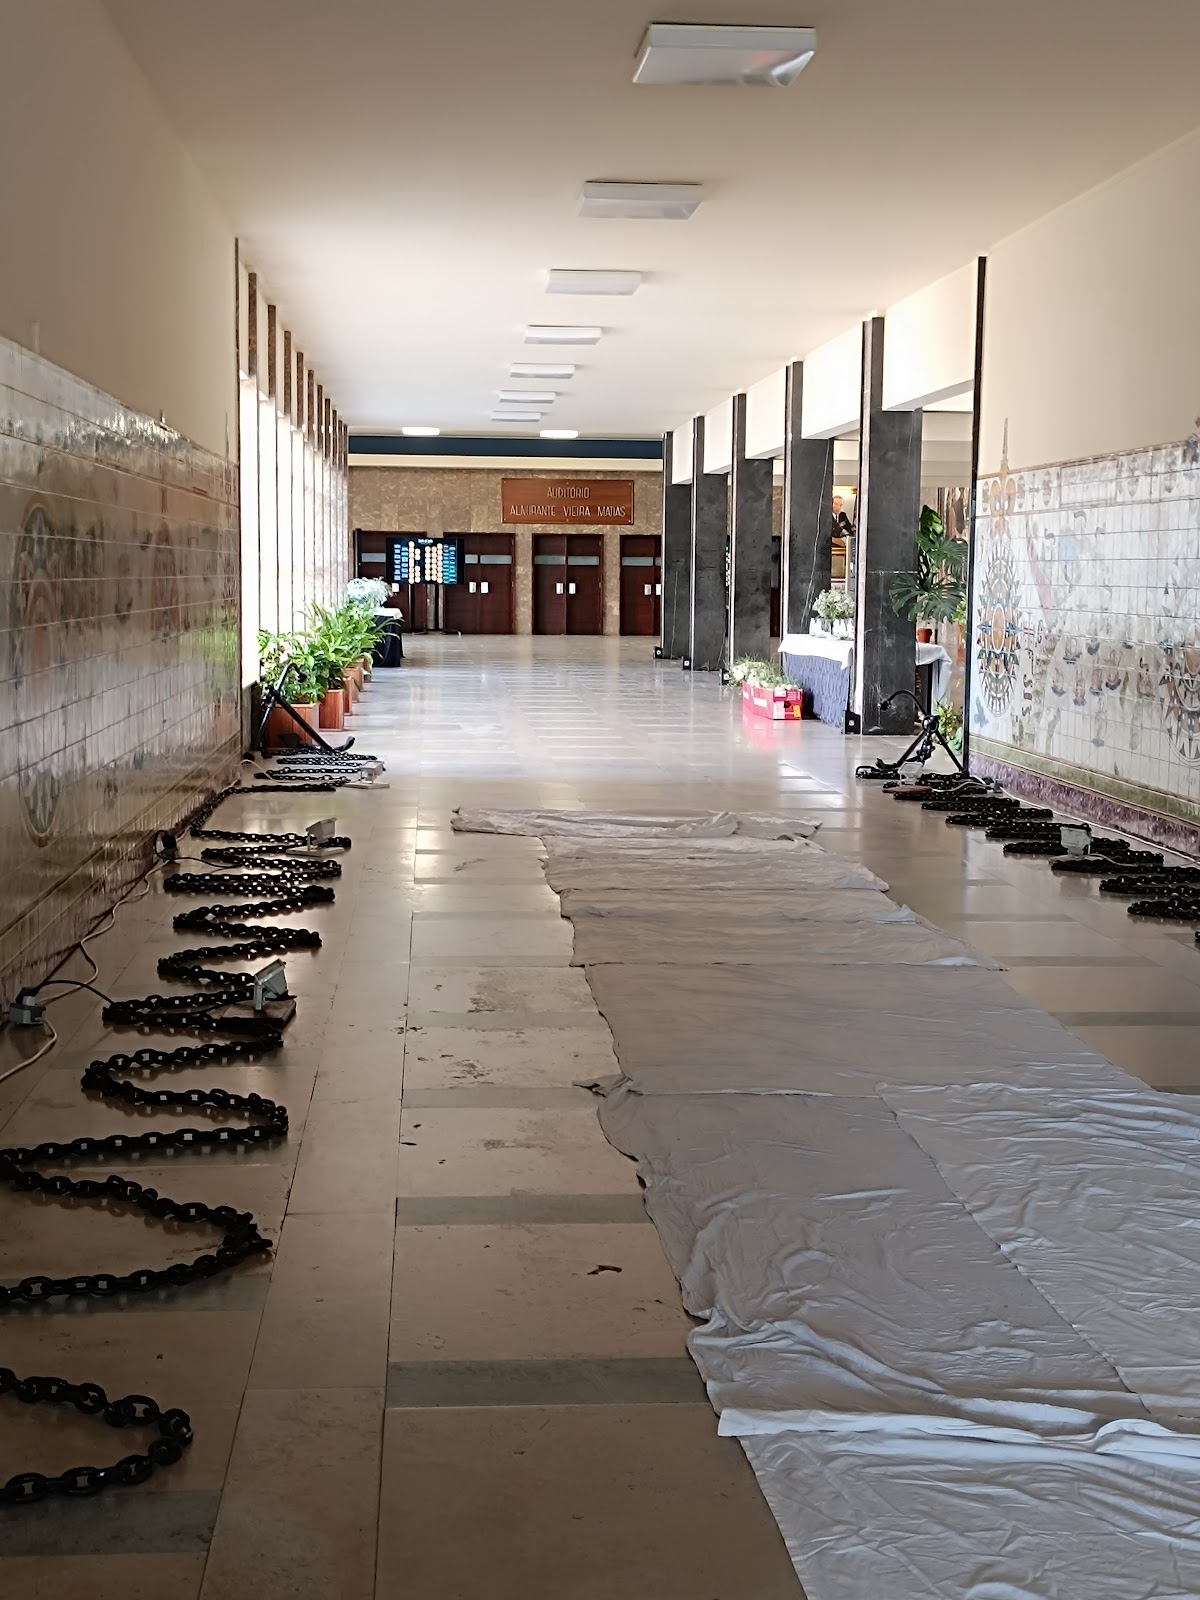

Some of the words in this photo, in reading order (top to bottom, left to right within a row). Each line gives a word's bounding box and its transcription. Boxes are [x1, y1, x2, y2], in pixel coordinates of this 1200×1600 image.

[509, 504, 556, 517] ALMIRANTE
[563, 505, 591, 517] VIEIRA
[597, 505, 626, 518] MATIAS
